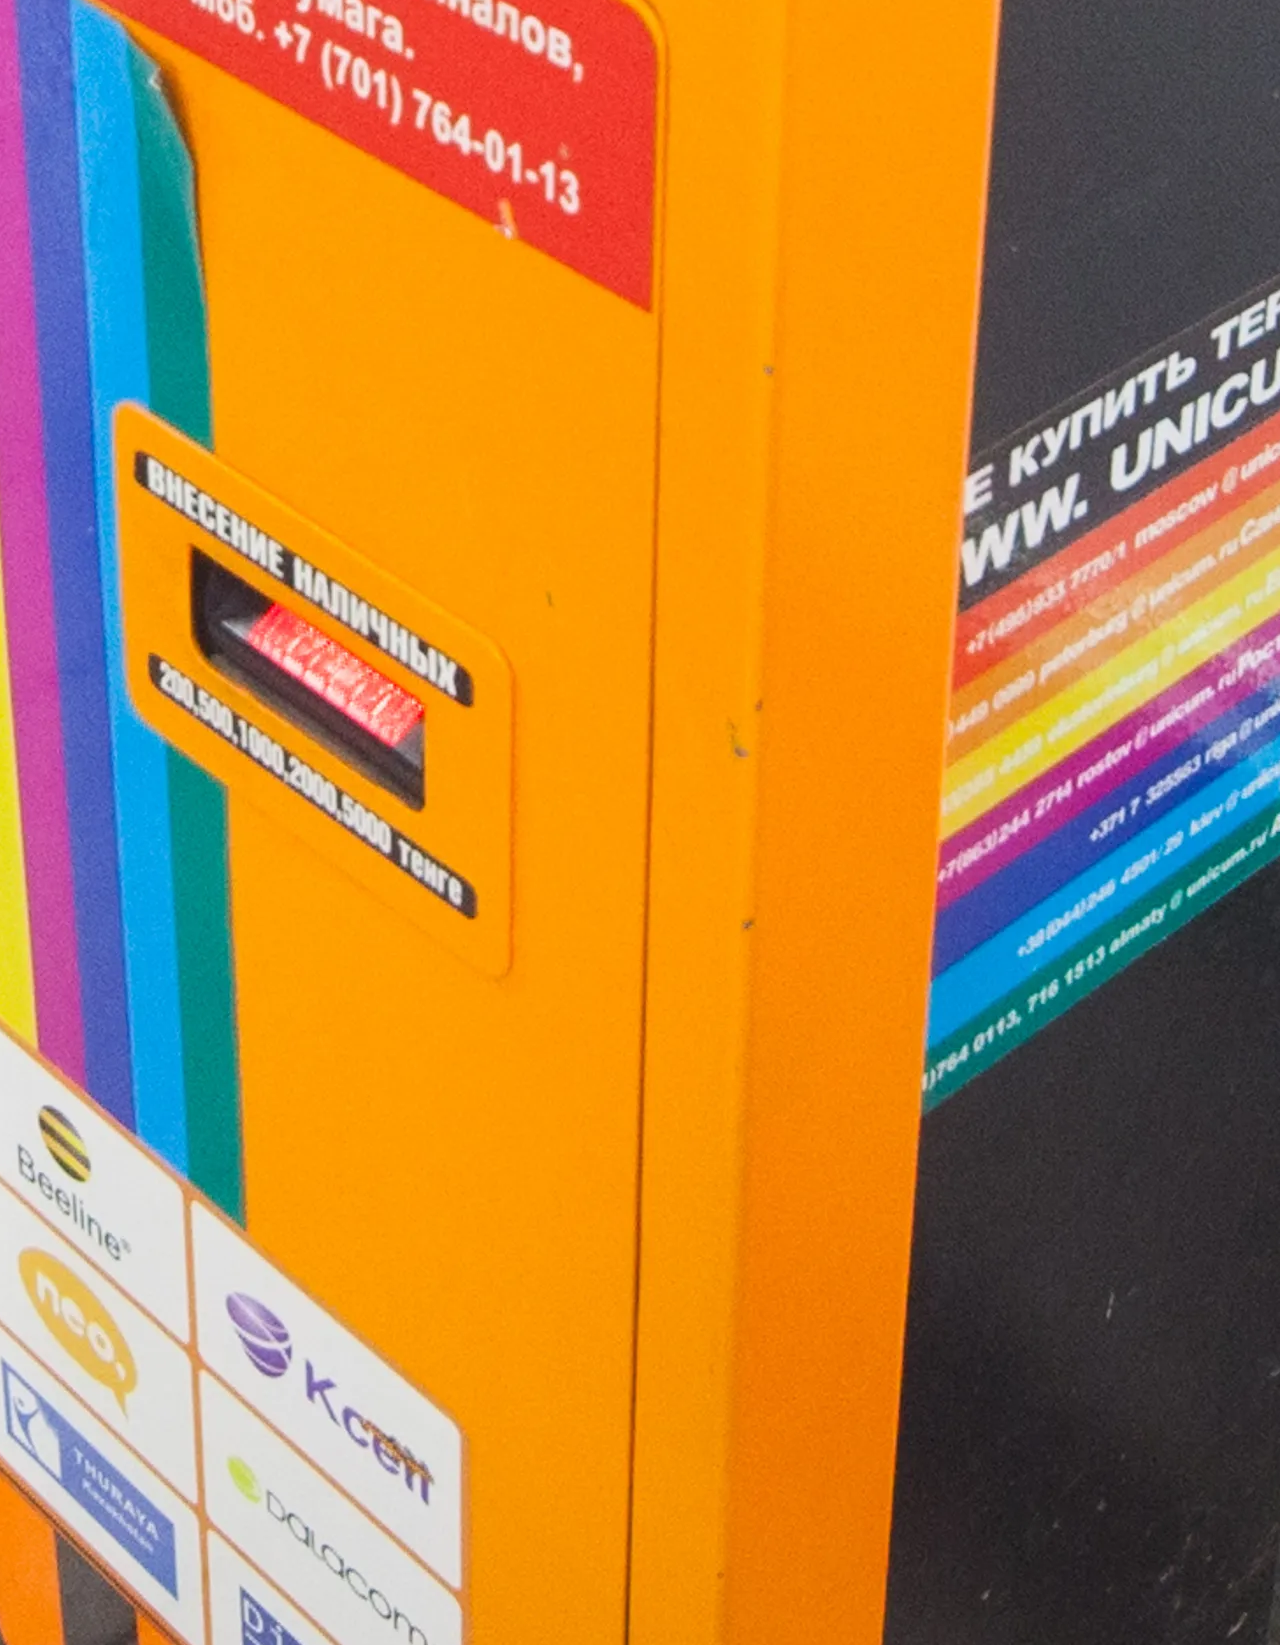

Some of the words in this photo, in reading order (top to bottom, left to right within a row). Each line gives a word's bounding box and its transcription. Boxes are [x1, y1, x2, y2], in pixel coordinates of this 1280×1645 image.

[272, 19, 313, 64] +7
[319, 39, 403, 127] (701)
[410, 87, 582, 216] 764-01-13
[1007, 350, 1198, 488] КУПИТЬ
[1133, 482, 1219, 550] moscow
[145, 454, 287, 581] ВНЕСЕНИЕ
[291, 553, 460, 698] НАЛИЧНЫХ
[1076, 739, 1132, 789] rostov
[1203, 728, 1238, 769] riga
[396, 837, 465, 908] тенге
[1025, 978, 1059, 1015] 716
[1108, 902, 1167, 957] almaty
[15, 1143, 124, 1263] Beeline
[71, 1445, 160, 1542] THURAYA
